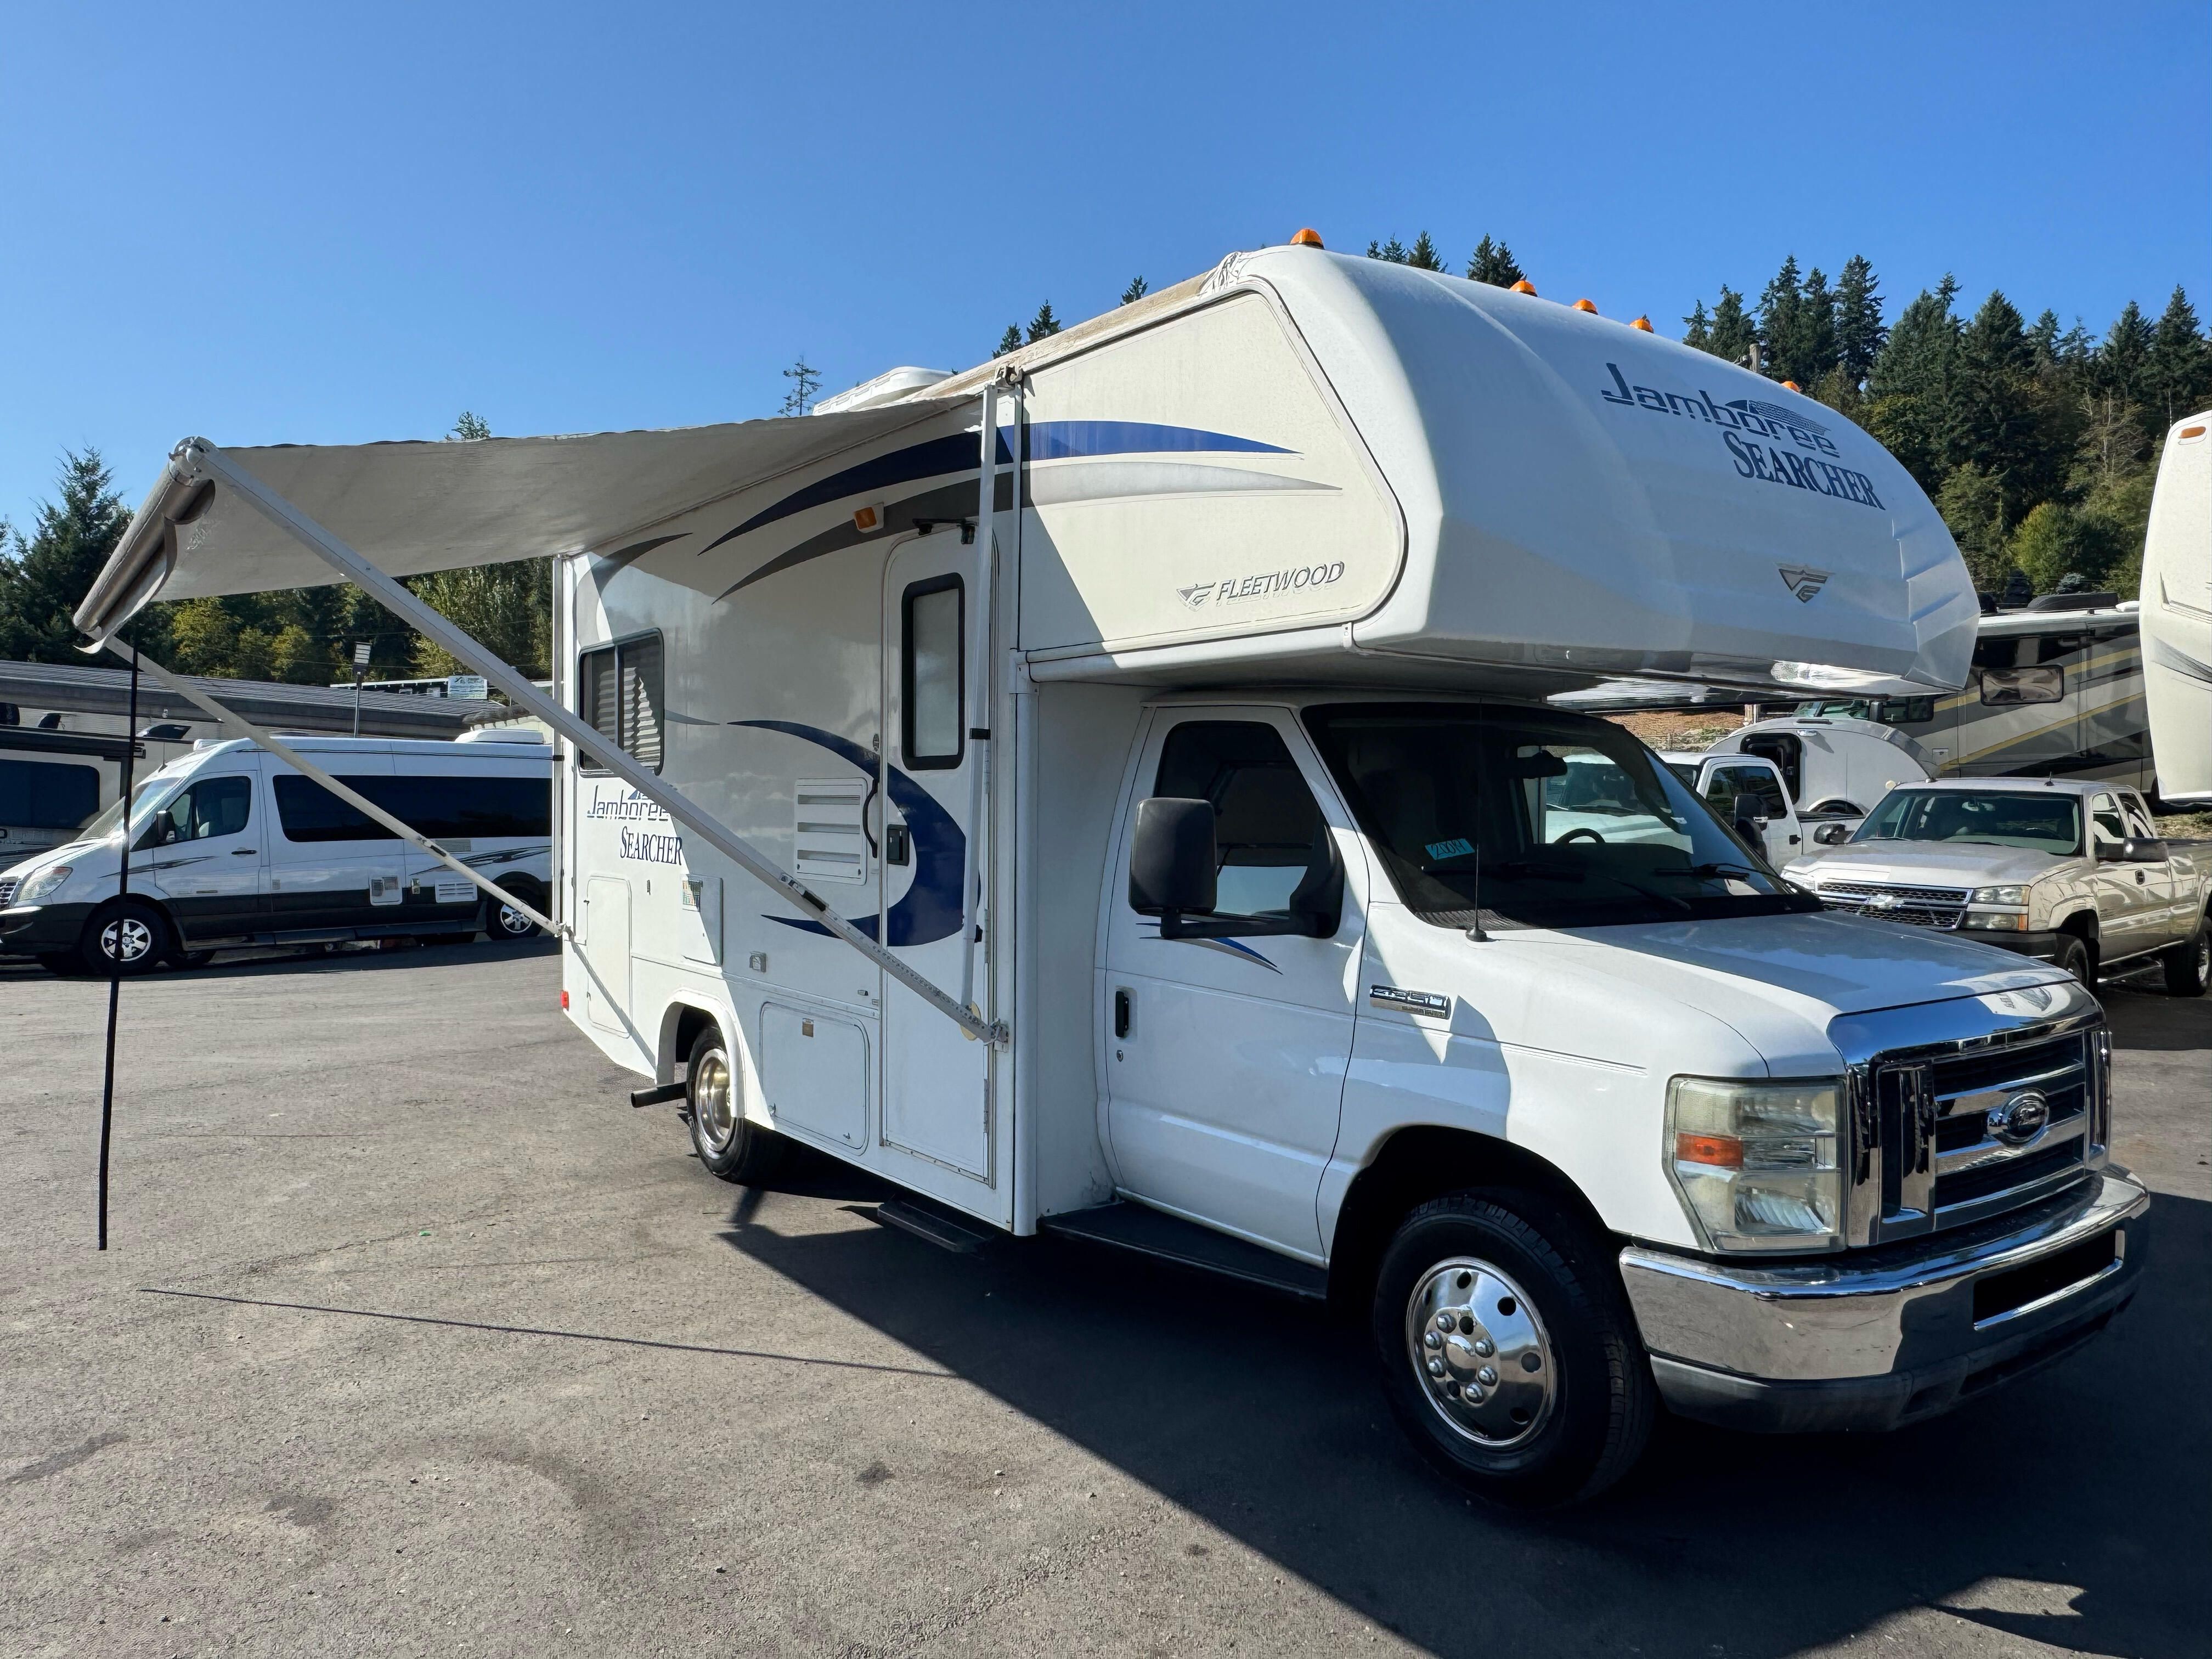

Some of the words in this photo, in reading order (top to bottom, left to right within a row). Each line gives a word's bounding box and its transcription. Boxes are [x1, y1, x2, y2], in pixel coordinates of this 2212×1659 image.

[1601, 363, 1840, 458] Jamboree
[1722, 430, 1886, 511] SEARCHER
[1216, 560, 1345, 601] FLEETWOOD
[620, 826, 682, 866] SEARCHER
